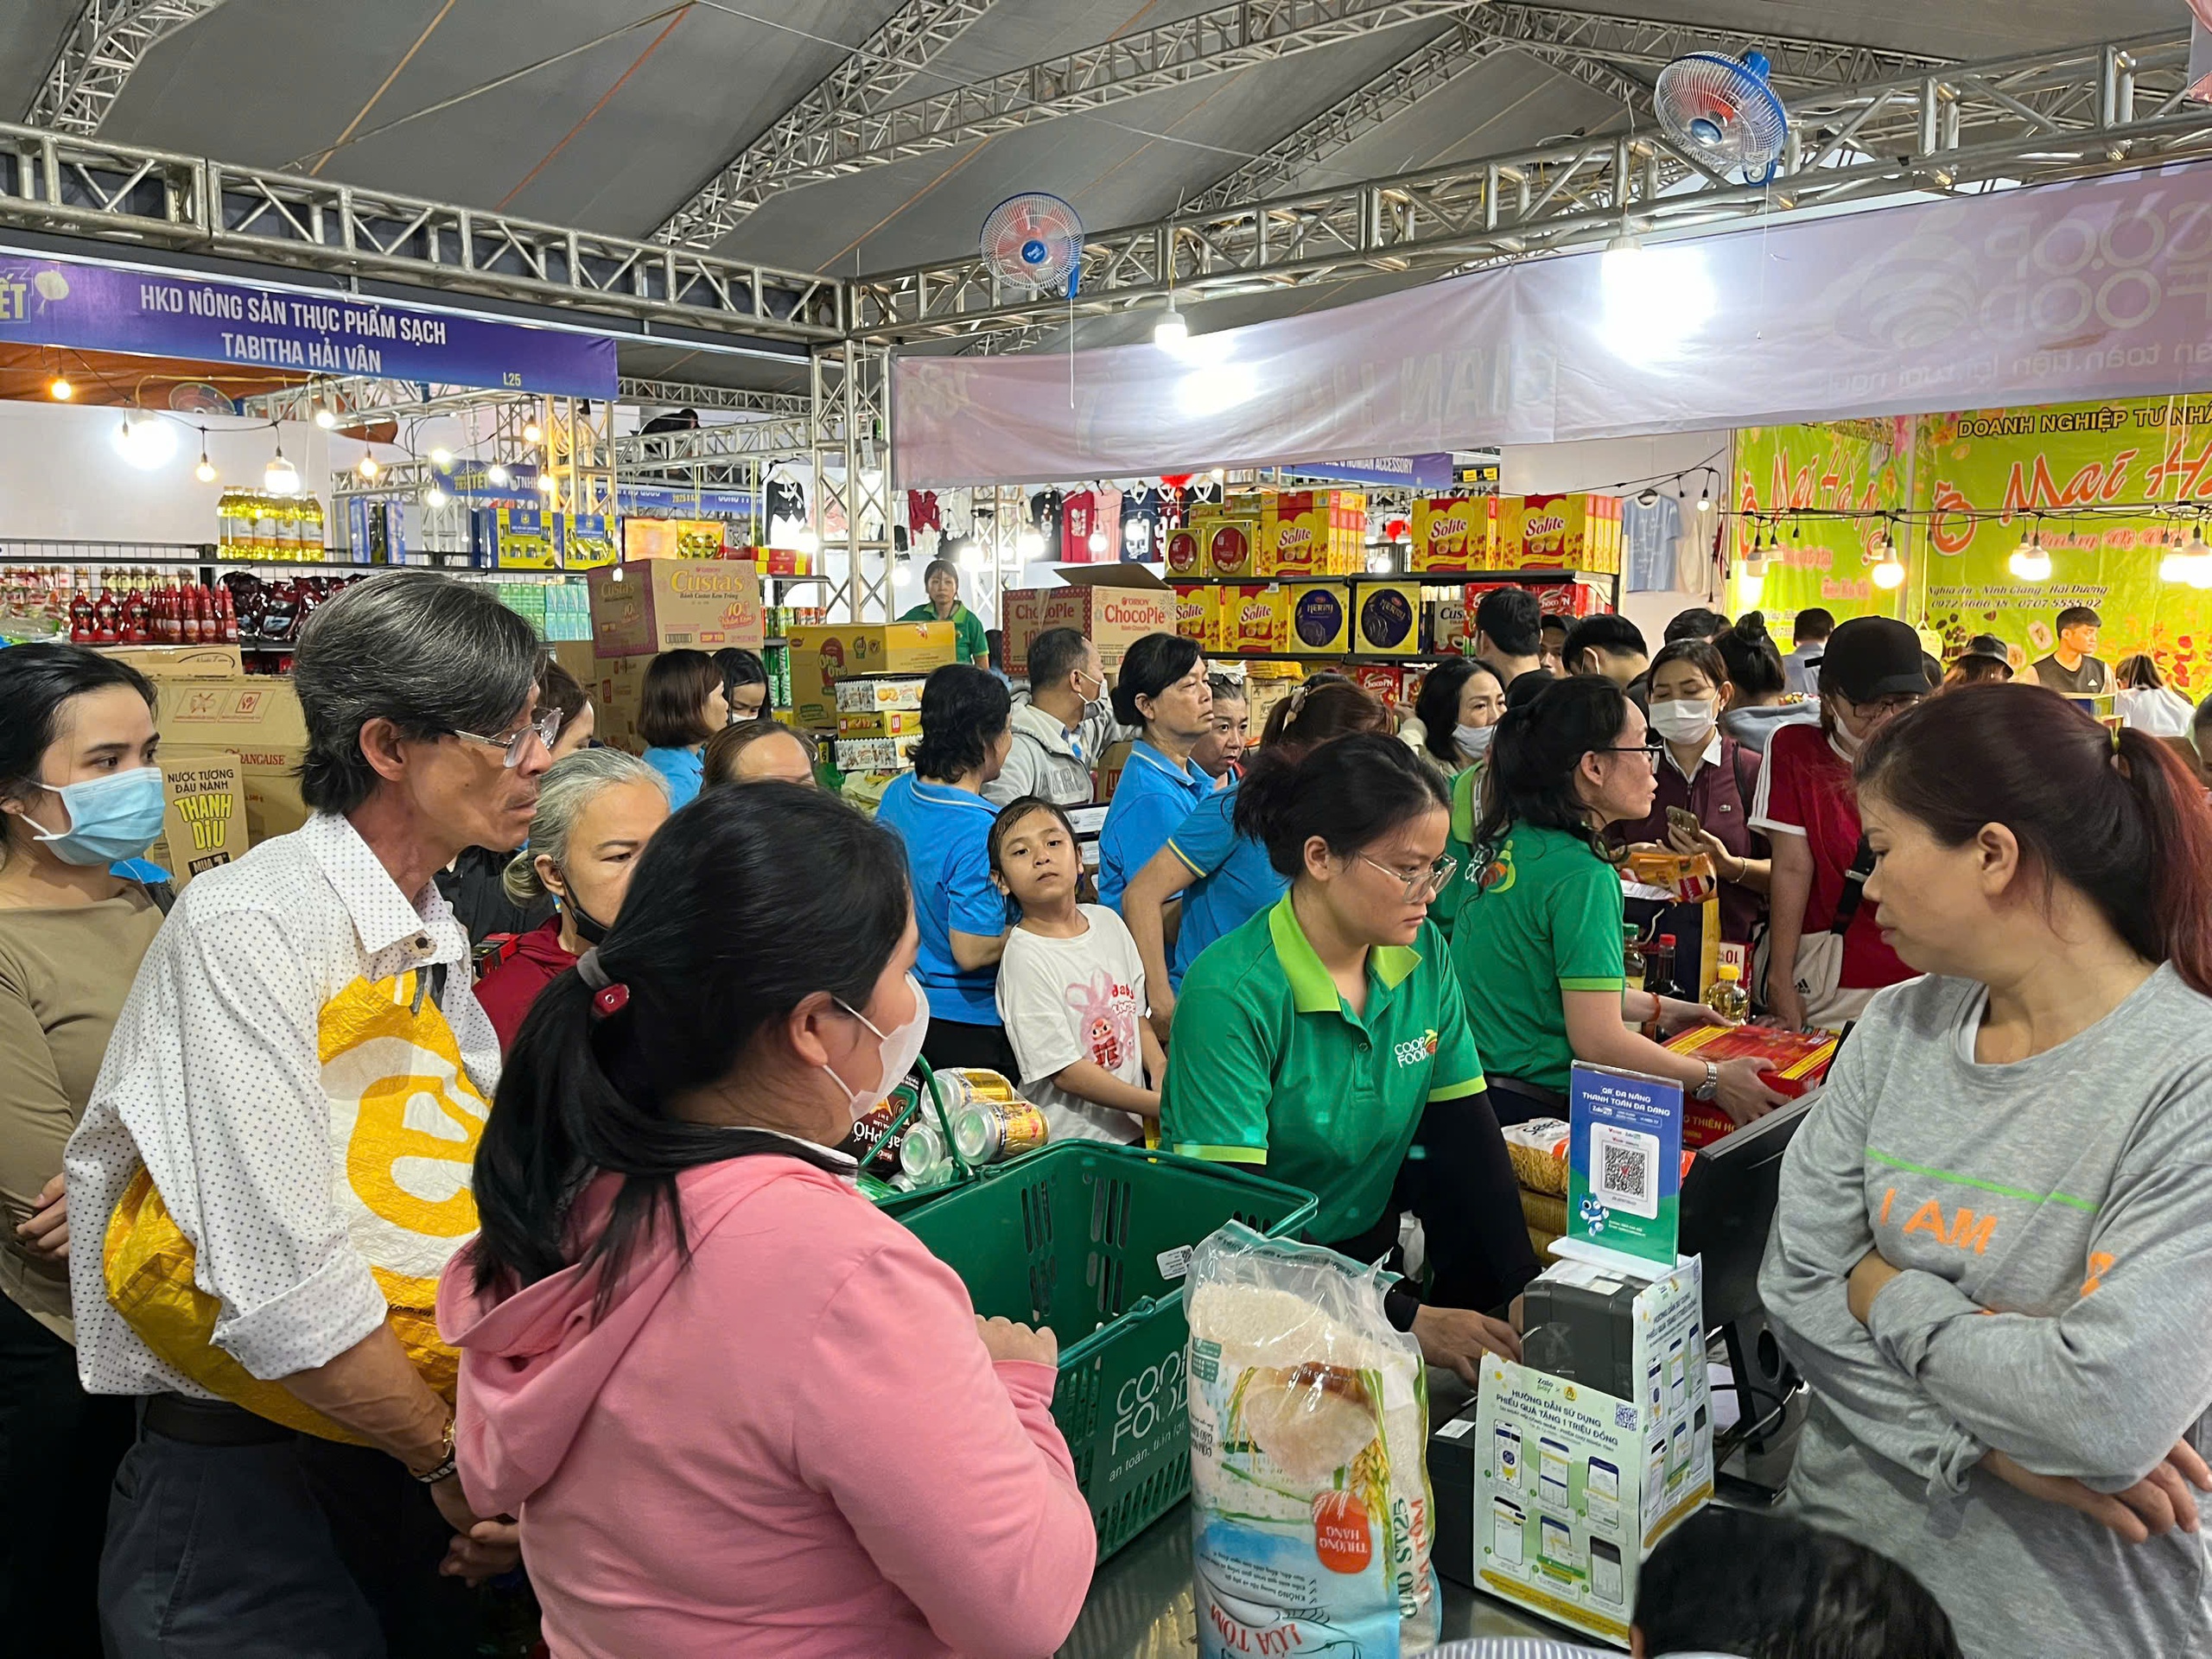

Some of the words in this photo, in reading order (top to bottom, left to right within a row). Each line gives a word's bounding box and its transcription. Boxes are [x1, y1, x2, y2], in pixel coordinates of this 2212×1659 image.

[141, 284, 182, 313] HKD
[188, 287, 243, 320] NÔNG
[247, 292, 287, 325] SẢN
[291, 302, 340, 334] THỰC
[344, 304, 396, 339] PHẨM
[400, 319, 446, 346] SẠCH
[221, 333, 303, 365] TABITHA
[308, 338, 340, 369] HẢI
[344, 344, 381, 373] VÂN
[503, 372, 521, 387] L25
[1958, 416, 2034, 437] DOANH
[2041, 407, 2127, 433] NGHIỆP
[2135, 405, 2167, 427] TƯ
[1376, 456, 1414, 474] ACCESSORY
[1431, 518, 1467, 539] Solite
[1525, 516, 1565, 537] Solite
[1280, 528, 1312, 547] Solite
[671, 569, 744, 593] Custas
[1104, 605, 1166, 625] ChocoPie
[1175, 602, 1205, 620] Solite
[1240, 602, 1272, 622] Solite
[167, 771, 196, 784] NƯỚC
[198, 768, 234, 781] TƯƠNG
[173, 793, 233, 822] THANH
[191, 819, 226, 851] DỊU
[1582, 1091, 1609, 1103] THANH
[1693, 1116, 1722, 1131] THIÊN
[1879, 1188, 1896, 1227] I
[1904, 1199, 1998, 1256] AM
[1512, 1389, 1541, 1407] HƯỚNG
[1393, 1497, 1413, 1564] ST25
[1278, 1590, 1306, 1603] KHÔNG
[1210, 1604, 1250, 1652] TÔM
[1255, 1623, 1303, 1659] LÚA
